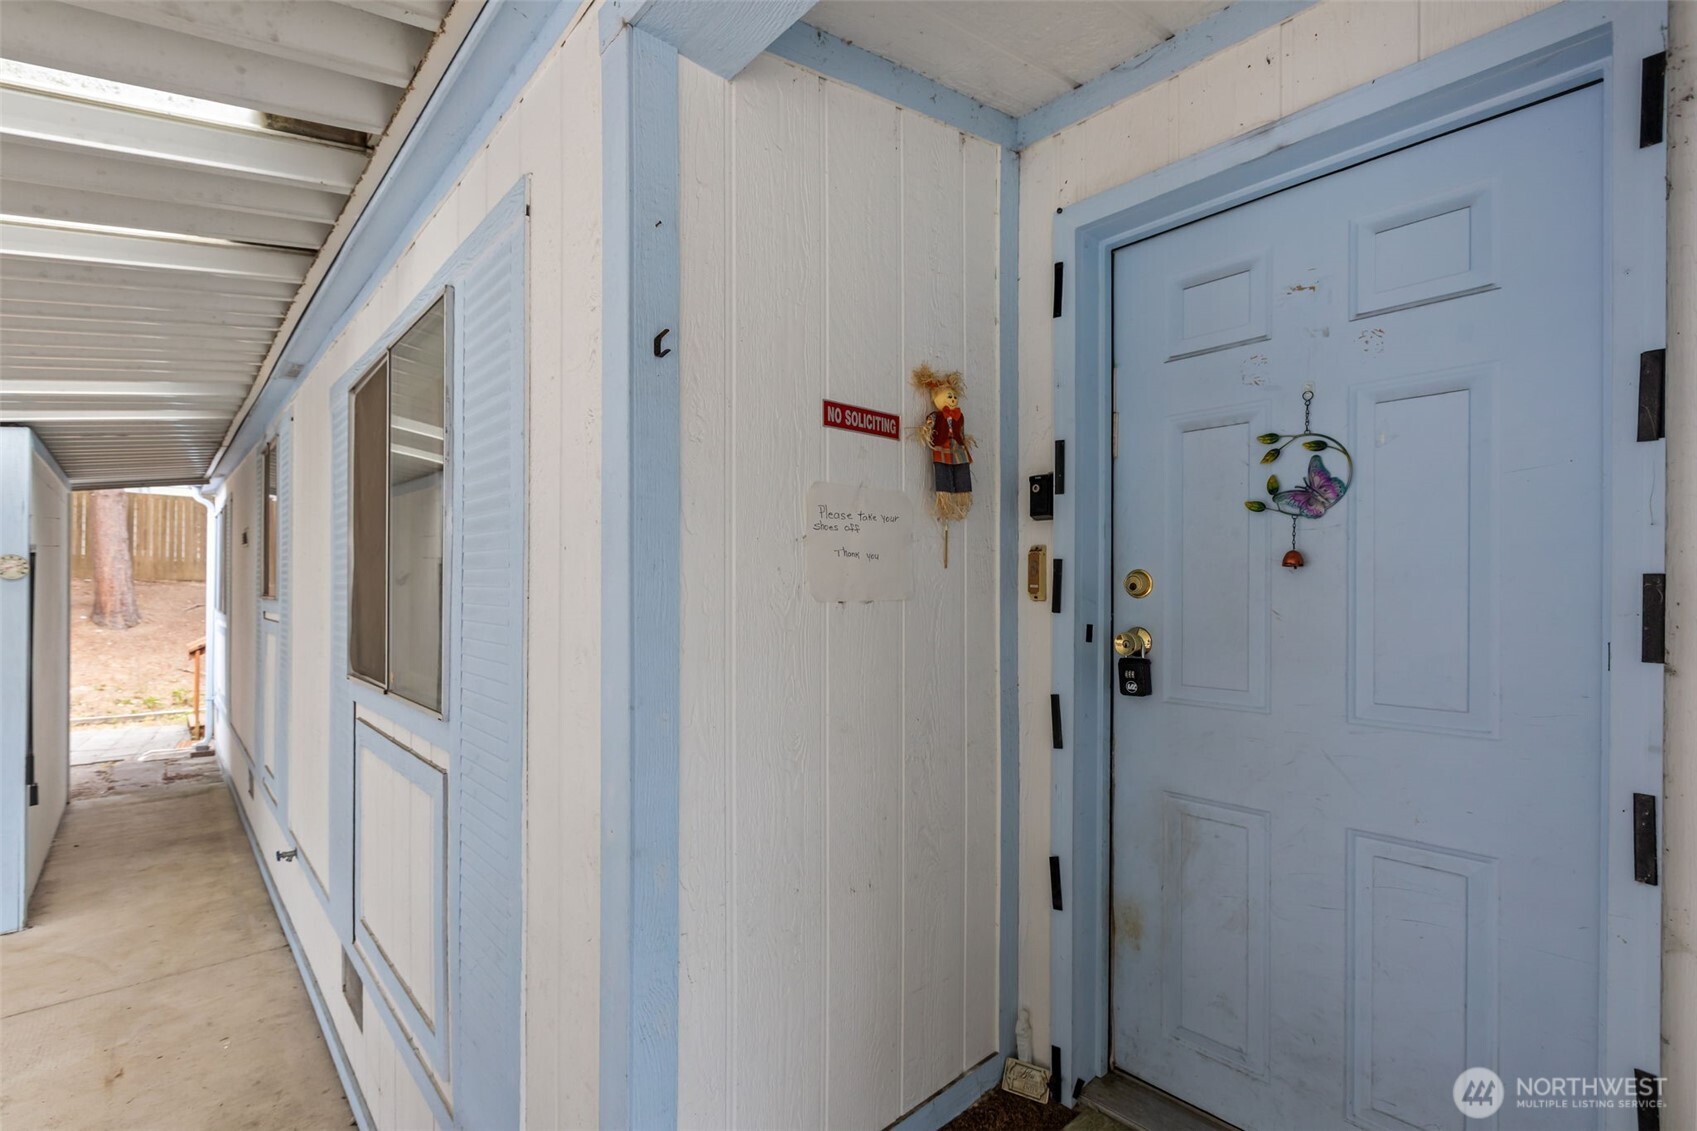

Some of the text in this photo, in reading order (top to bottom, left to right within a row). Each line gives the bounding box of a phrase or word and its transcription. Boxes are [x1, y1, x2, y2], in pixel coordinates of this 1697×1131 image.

[827, 405, 897, 434] NO SOLICITING
[818, 504, 900, 524] Please take your
[844, 523, 861, 533] off
[834, 546, 880, 562] Thank you
